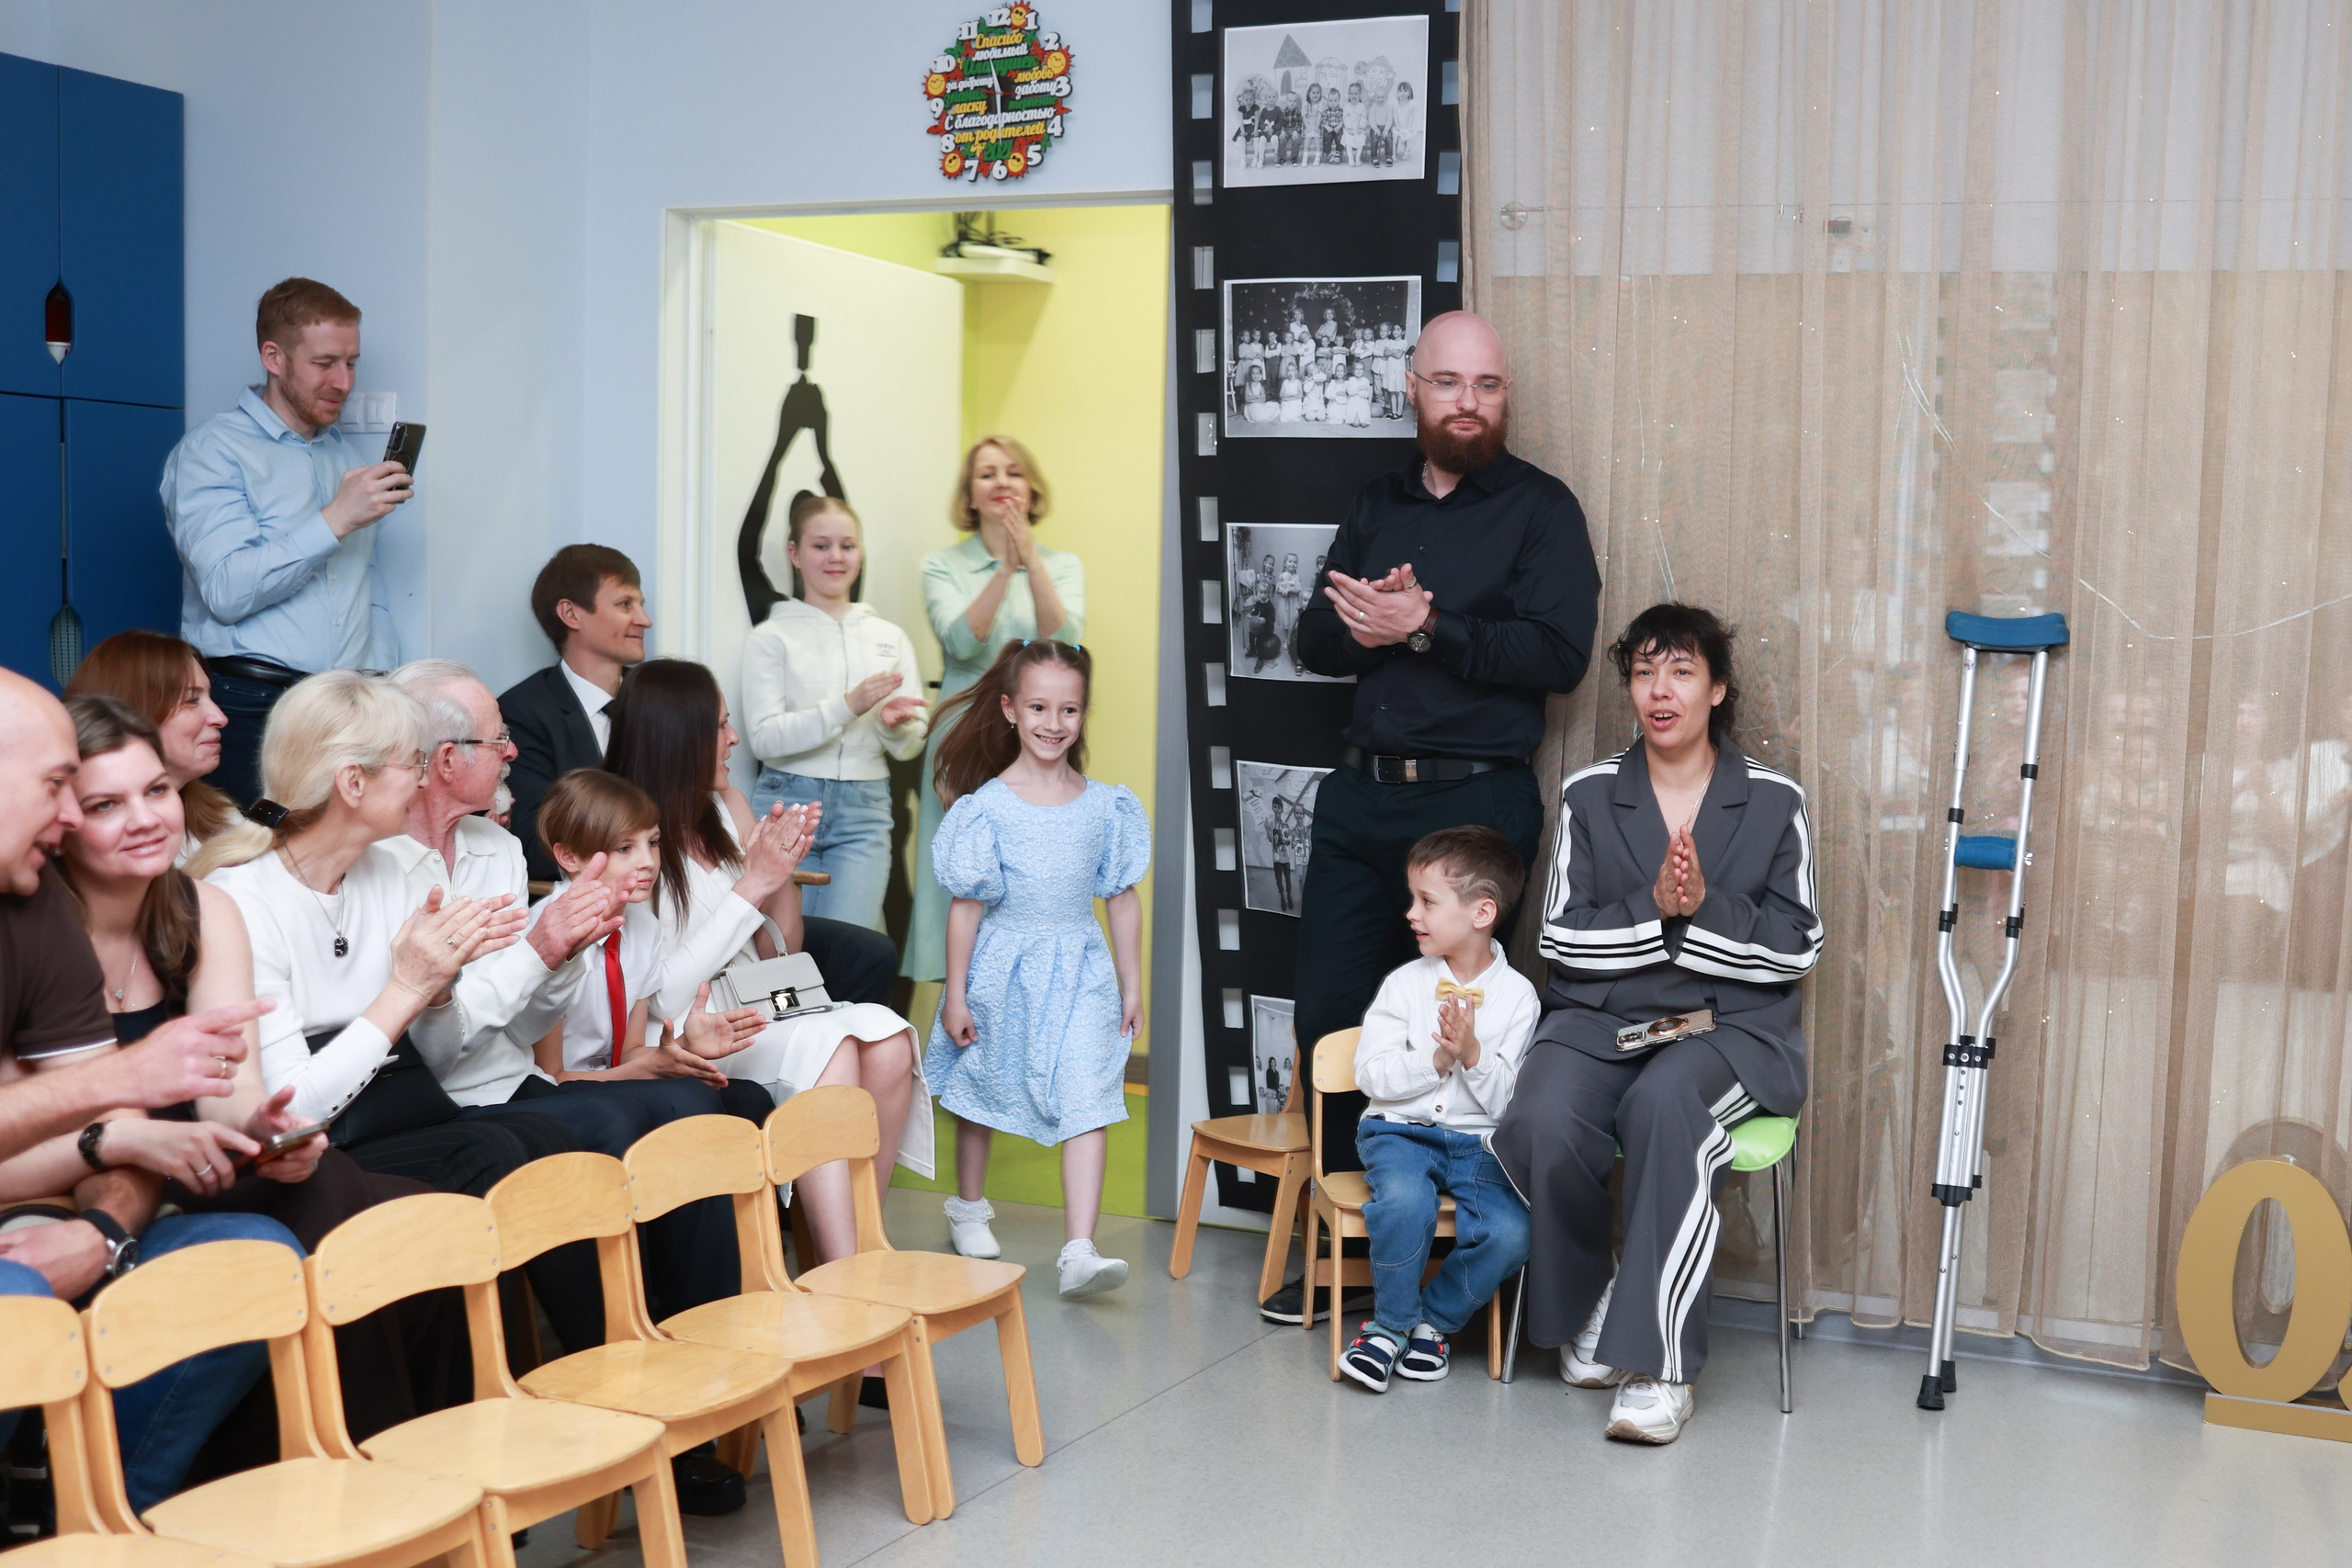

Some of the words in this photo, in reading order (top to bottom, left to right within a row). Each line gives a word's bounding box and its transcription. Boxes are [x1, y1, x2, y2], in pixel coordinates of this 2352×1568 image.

[988, 7, 1012, 28] 12
[1024, 11, 1039, 30] 1
[957, 20, 979, 40] 11
[975, 28, 1025, 50] Спасибо
[972, 42, 1029, 62] любимый
[1044, 32, 1060, 51] 2
[933, 55, 956, 73] 10
[1014, 65, 1054, 84] любовь
[945, 82, 957, 94] за
[957, 76, 994, 92] доброту
[1014, 79, 1057, 100] заботу
[1055, 75, 1071, 97] 3
[930, 97, 945, 118] 9
[953, 100, 988, 115] ласку
[944, 115, 954, 130] С
[955, 131, 975, 144] от
[974, 120, 1046, 145] родителей
[1047, 115, 1063, 137] 4
[941, 133, 956, 153] 8
[983, 141, 1013, 162] 2021
[1027, 144, 1043, 166] 5
[965, 160, 979, 181] 7
[992, 159, 1008, 180] 6
